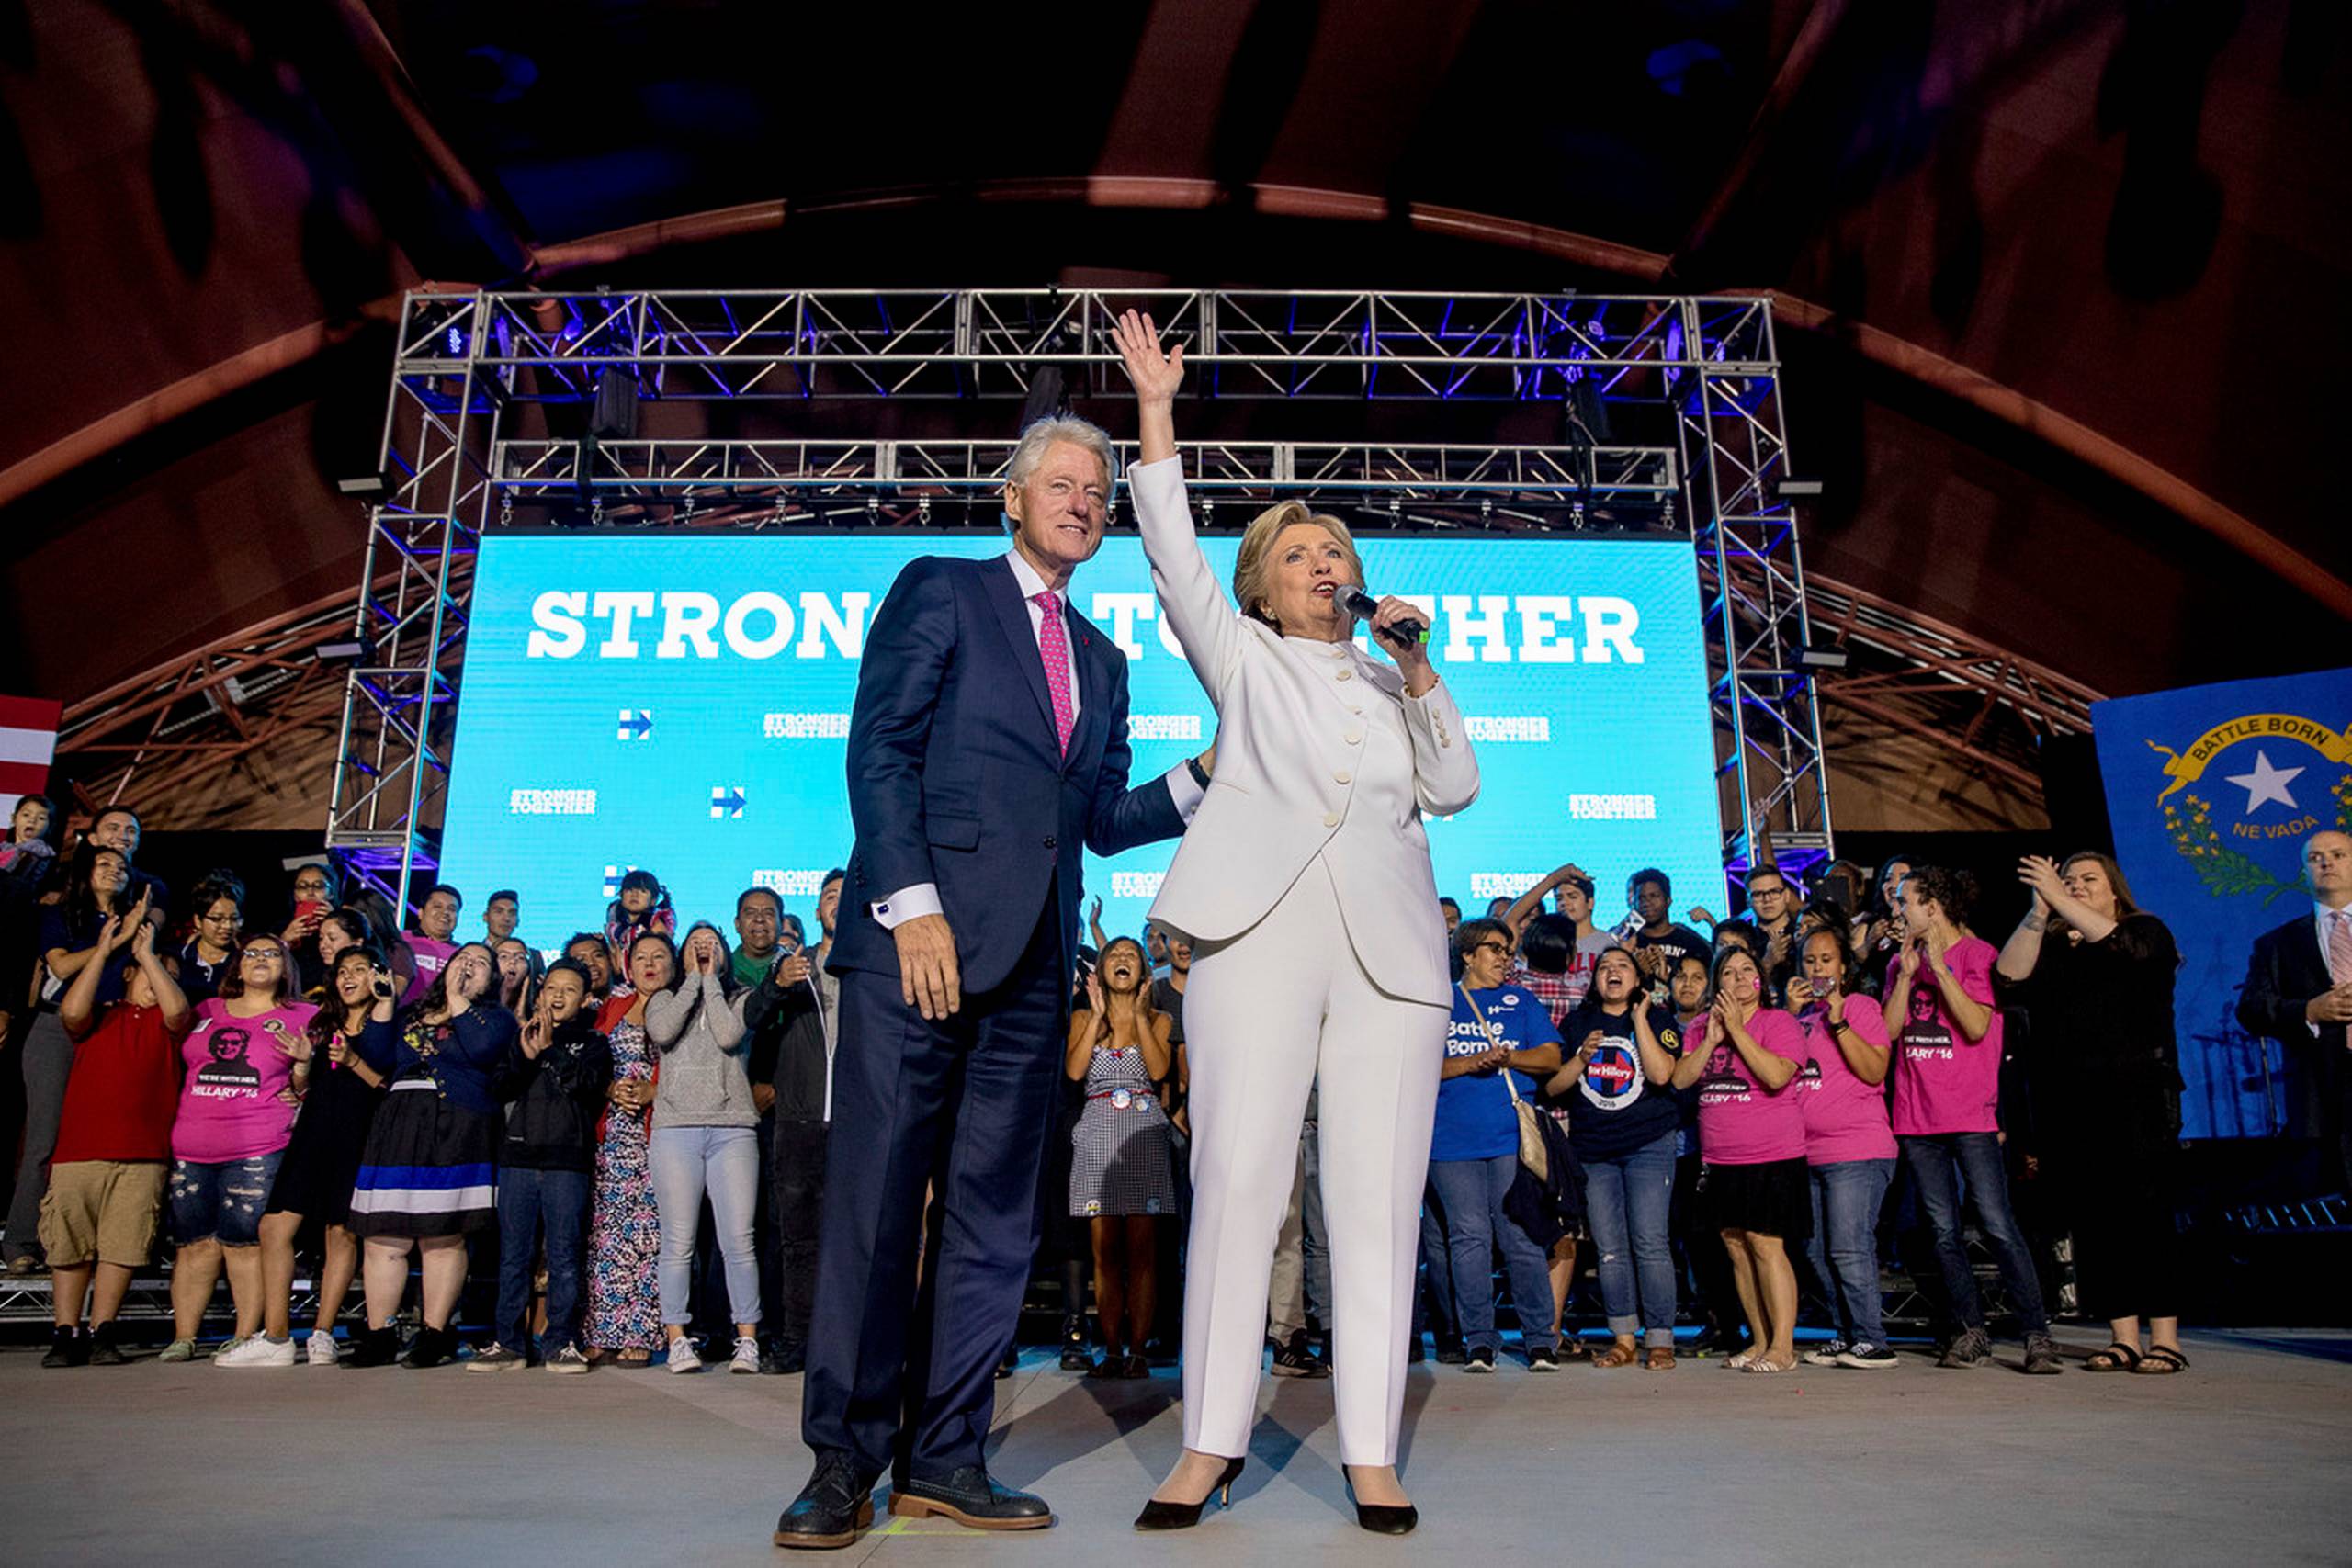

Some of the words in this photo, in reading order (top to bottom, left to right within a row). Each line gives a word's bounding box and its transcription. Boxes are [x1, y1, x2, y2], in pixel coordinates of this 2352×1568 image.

[527, 590, 882, 660] STRON
[1092, 592, 1644, 663] THER
[764, 713, 849, 726] STRONGER
[1126, 715, 1200, 728] TRONGER
[763, 725, 849, 738] TOGETHER
[1128, 727, 1201, 739] OGETHER
[2192, 719, 2261, 761] BATTLE
[2267, 717, 2330, 746] BORN
[511, 789, 596, 802] STRONGER
[1569, 795, 1655, 807] STRONGER
[510, 802, 595, 815] TOGETHER
[1570, 807, 1656, 819] TOGETHER
[2233, 815, 2320, 839] NEVADA
[191, 1086, 240, 1098] HILLARY
